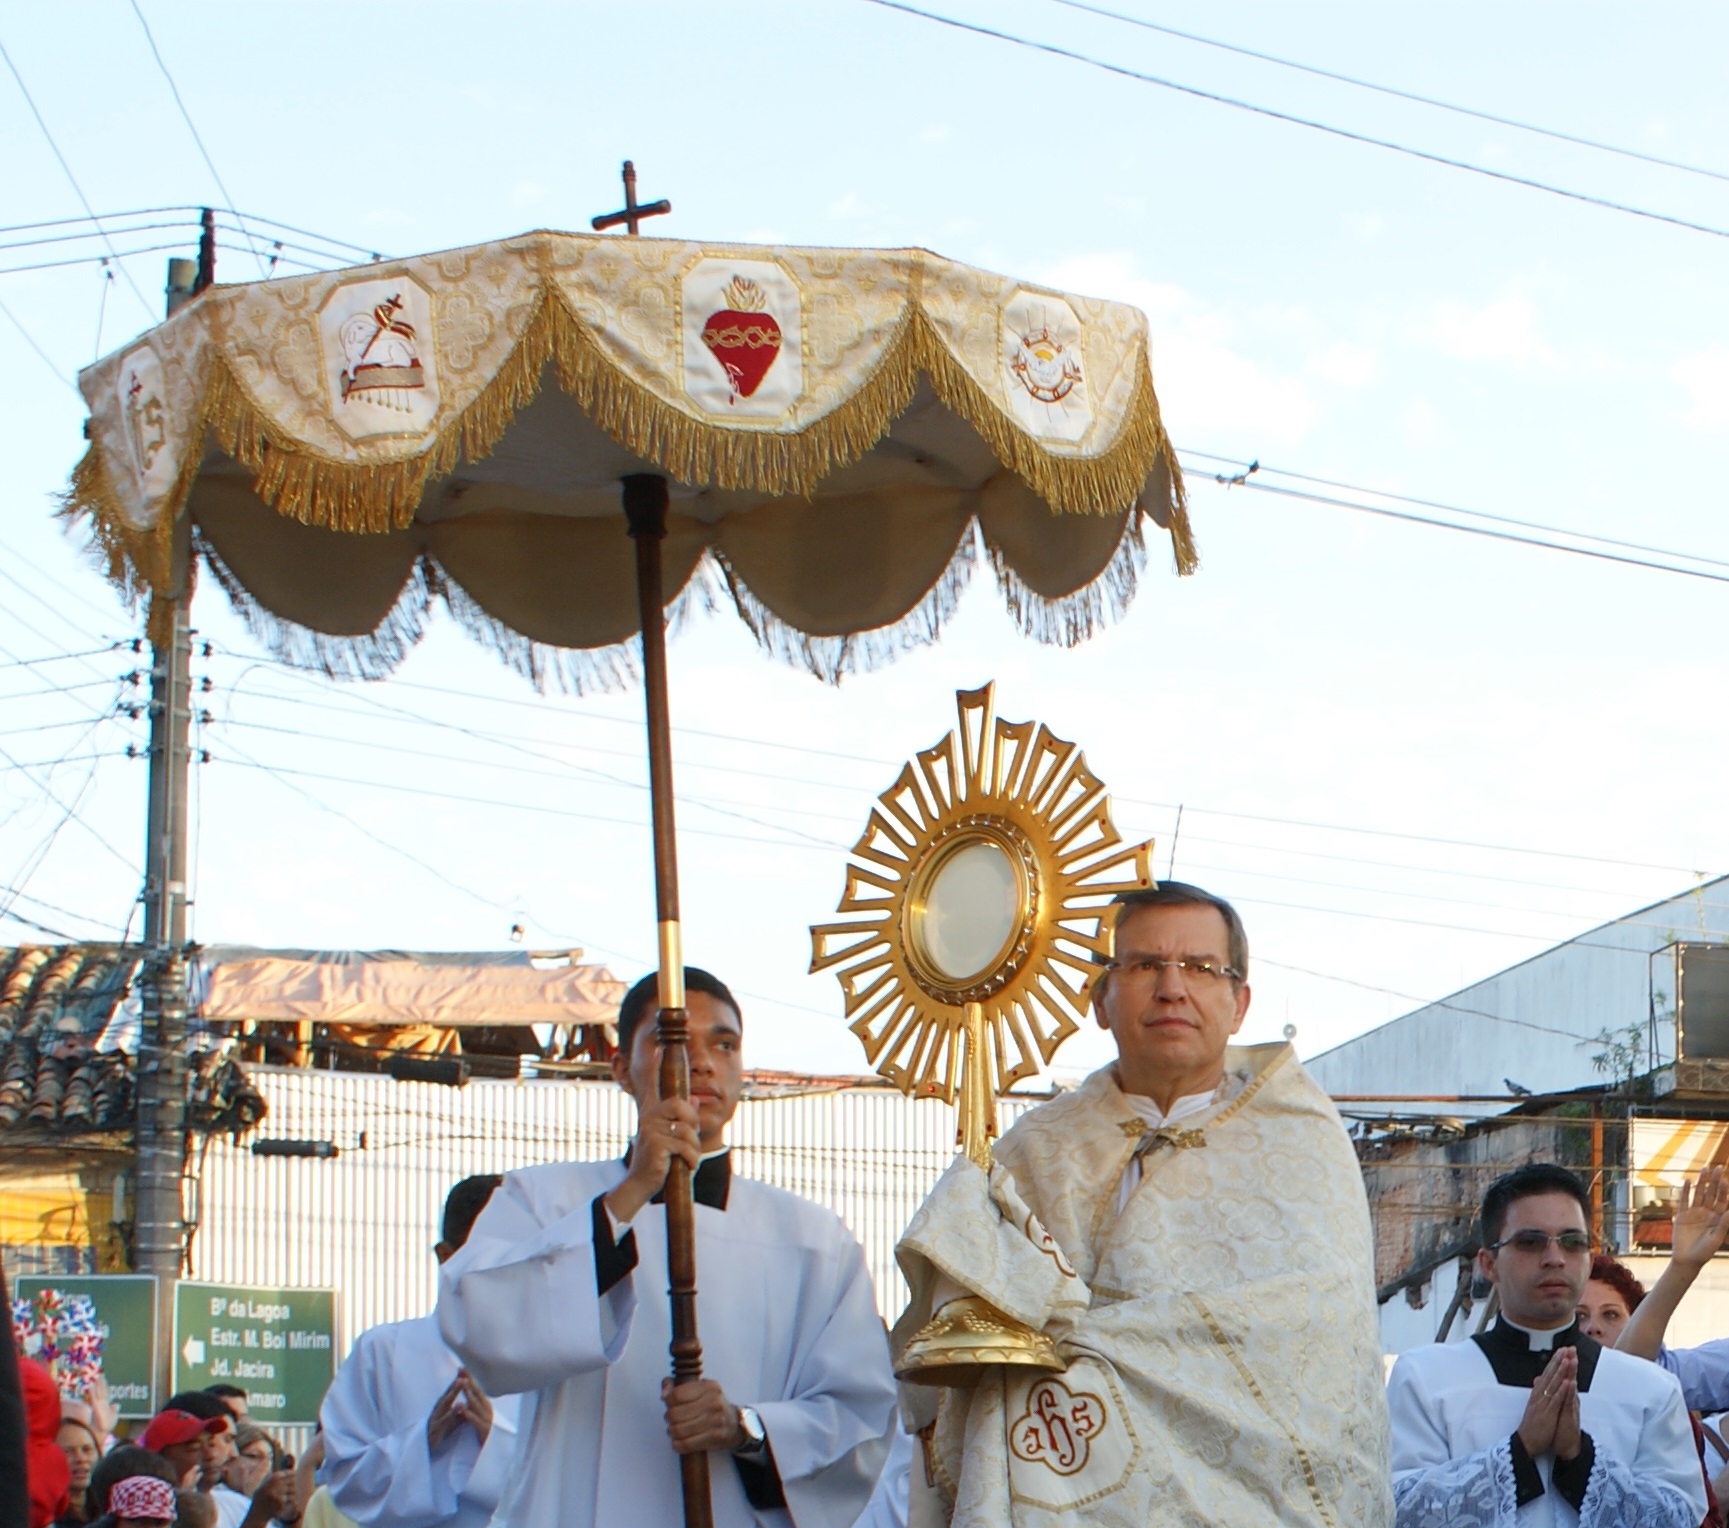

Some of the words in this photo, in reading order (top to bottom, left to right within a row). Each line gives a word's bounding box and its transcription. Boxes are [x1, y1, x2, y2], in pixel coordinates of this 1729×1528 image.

[229, 1299, 246, 1318] da
[248, 1299, 290, 1323] Lagoa
[210, 1327, 241, 1346] Estr.
[244, 1329, 259, 1348] M.
[262, 1330, 286, 1349] Boi
[290, 1331, 330, 1350] Mirim
[210, 1358, 231, 1376] Jd.
[234, 1359, 274, 1379] Jacira
